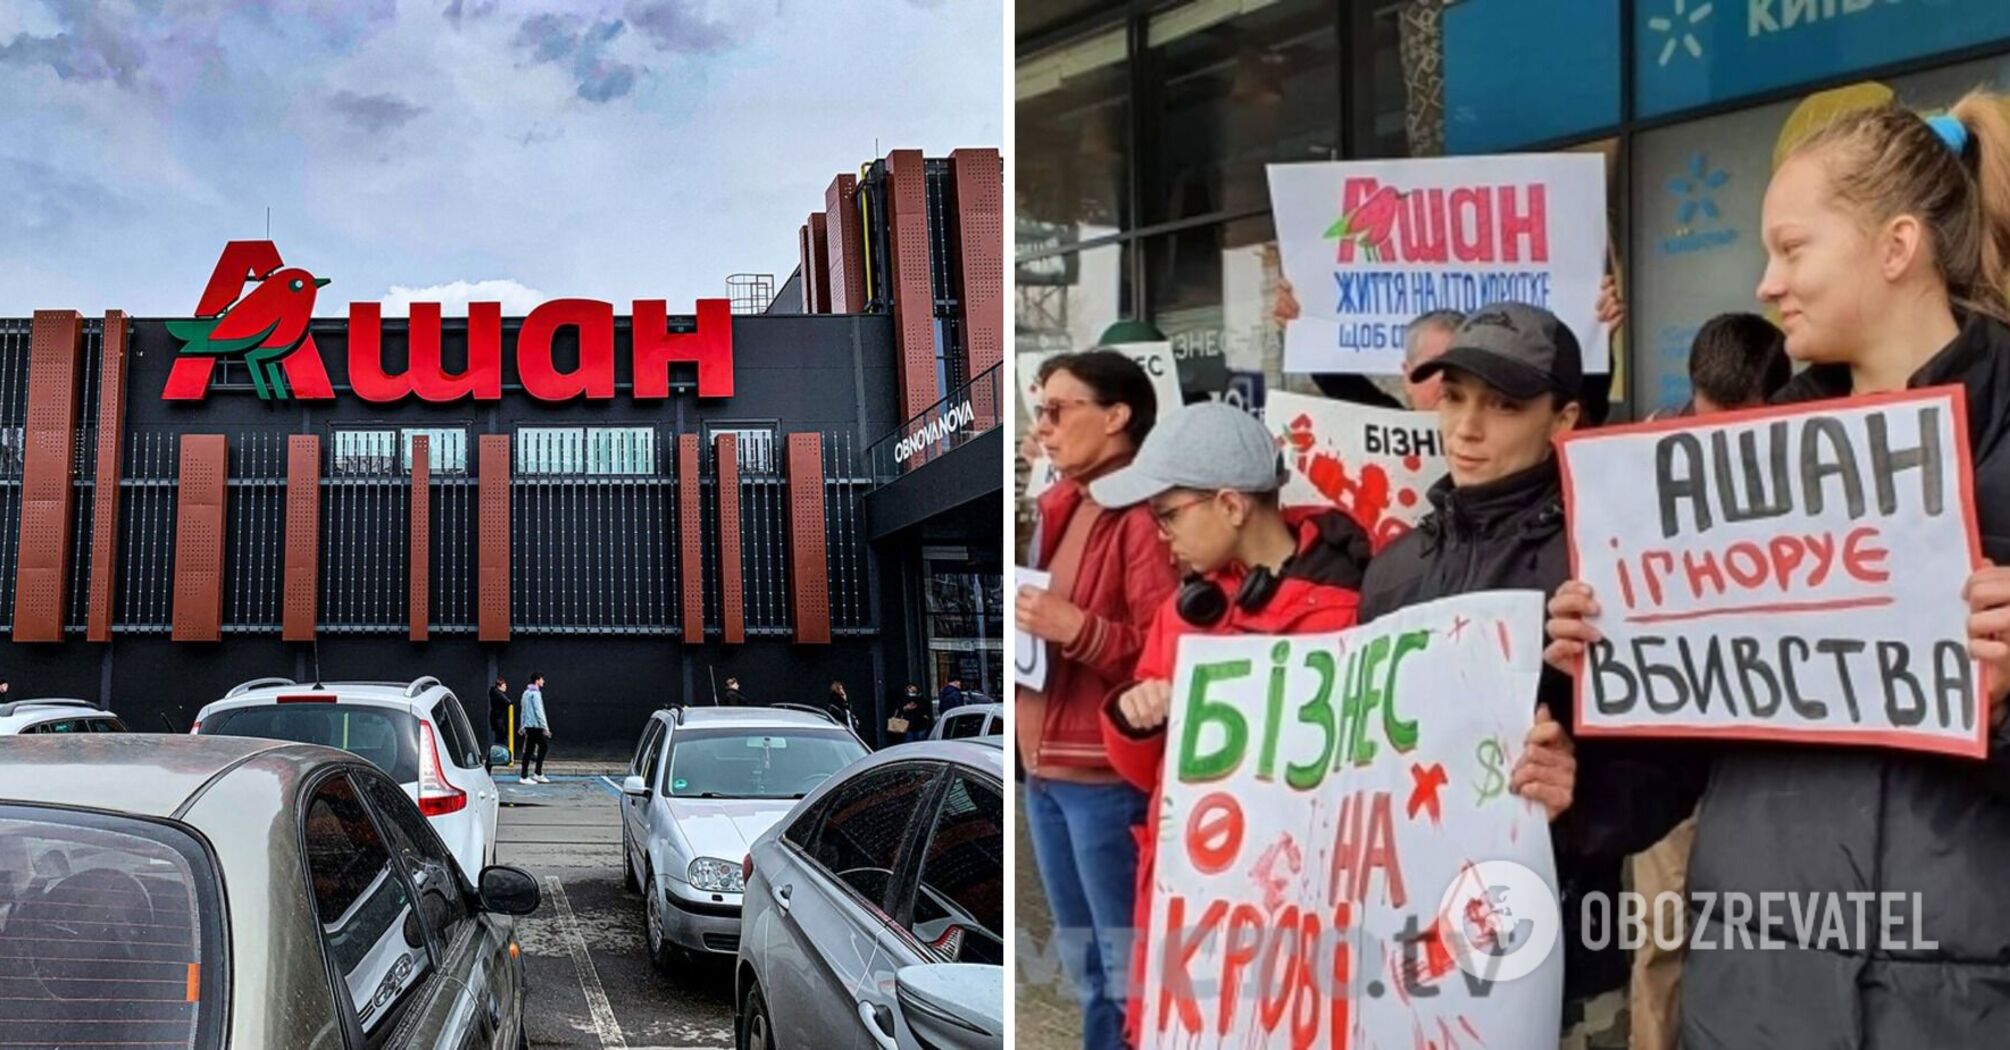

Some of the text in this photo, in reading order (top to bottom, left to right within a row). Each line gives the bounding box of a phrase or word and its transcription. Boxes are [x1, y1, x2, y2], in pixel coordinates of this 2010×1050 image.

[162, 240, 734, 403] Ашан
[1333, 271, 1408, 315] ЖИТТЯ
[1411, 271, 1476, 315] НАДТО
[1338, 322, 1388, 353] ЩОБ
[1364, 423, 1446, 457] БІЗН
[1655, 407, 1945, 539] АШАН
[1178, 628, 1431, 792] БІЗНЕС
[1588, 634, 1976, 731] ВБИВСТВА
[1329, 790, 1407, 908] НА
[1159, 896, 1353, 1050] КРОВІ
